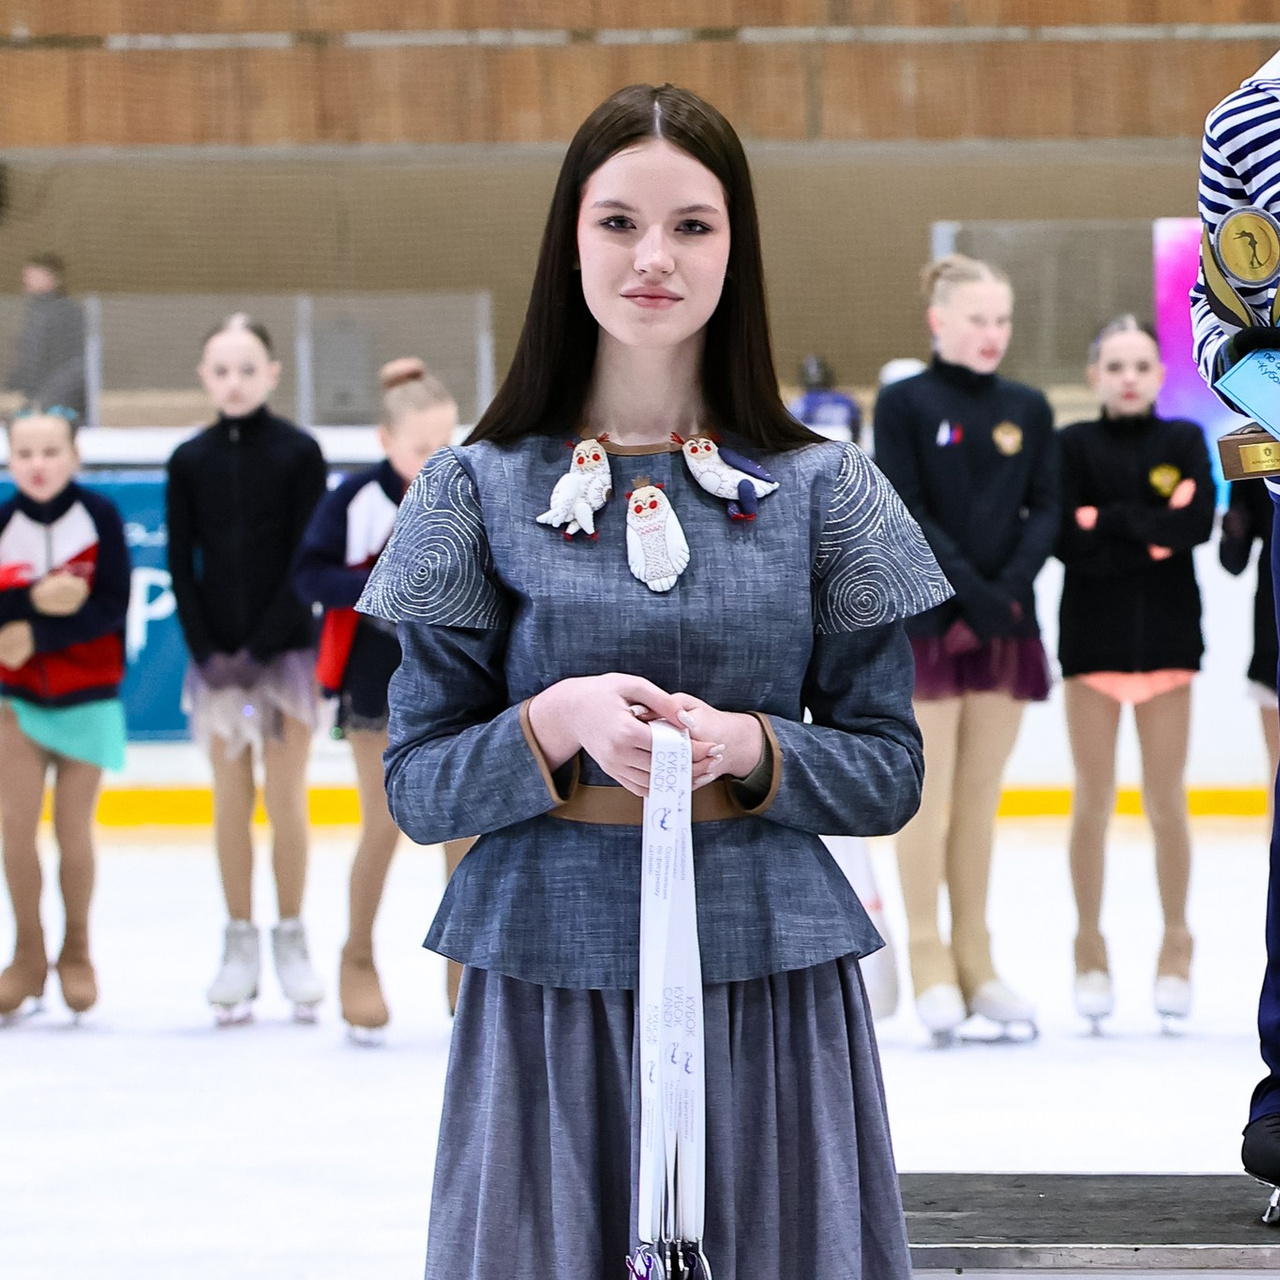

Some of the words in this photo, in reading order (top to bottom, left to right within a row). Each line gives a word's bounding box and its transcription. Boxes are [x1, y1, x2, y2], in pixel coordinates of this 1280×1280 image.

[1263, 352, 1276, 363] по
[653, 751, 666, 792] CANDY
[666, 751, 677, 793] КУБОК
[673, 986, 684, 1027] КУБОК
[684, 996, 696, 1037] КУБОК
